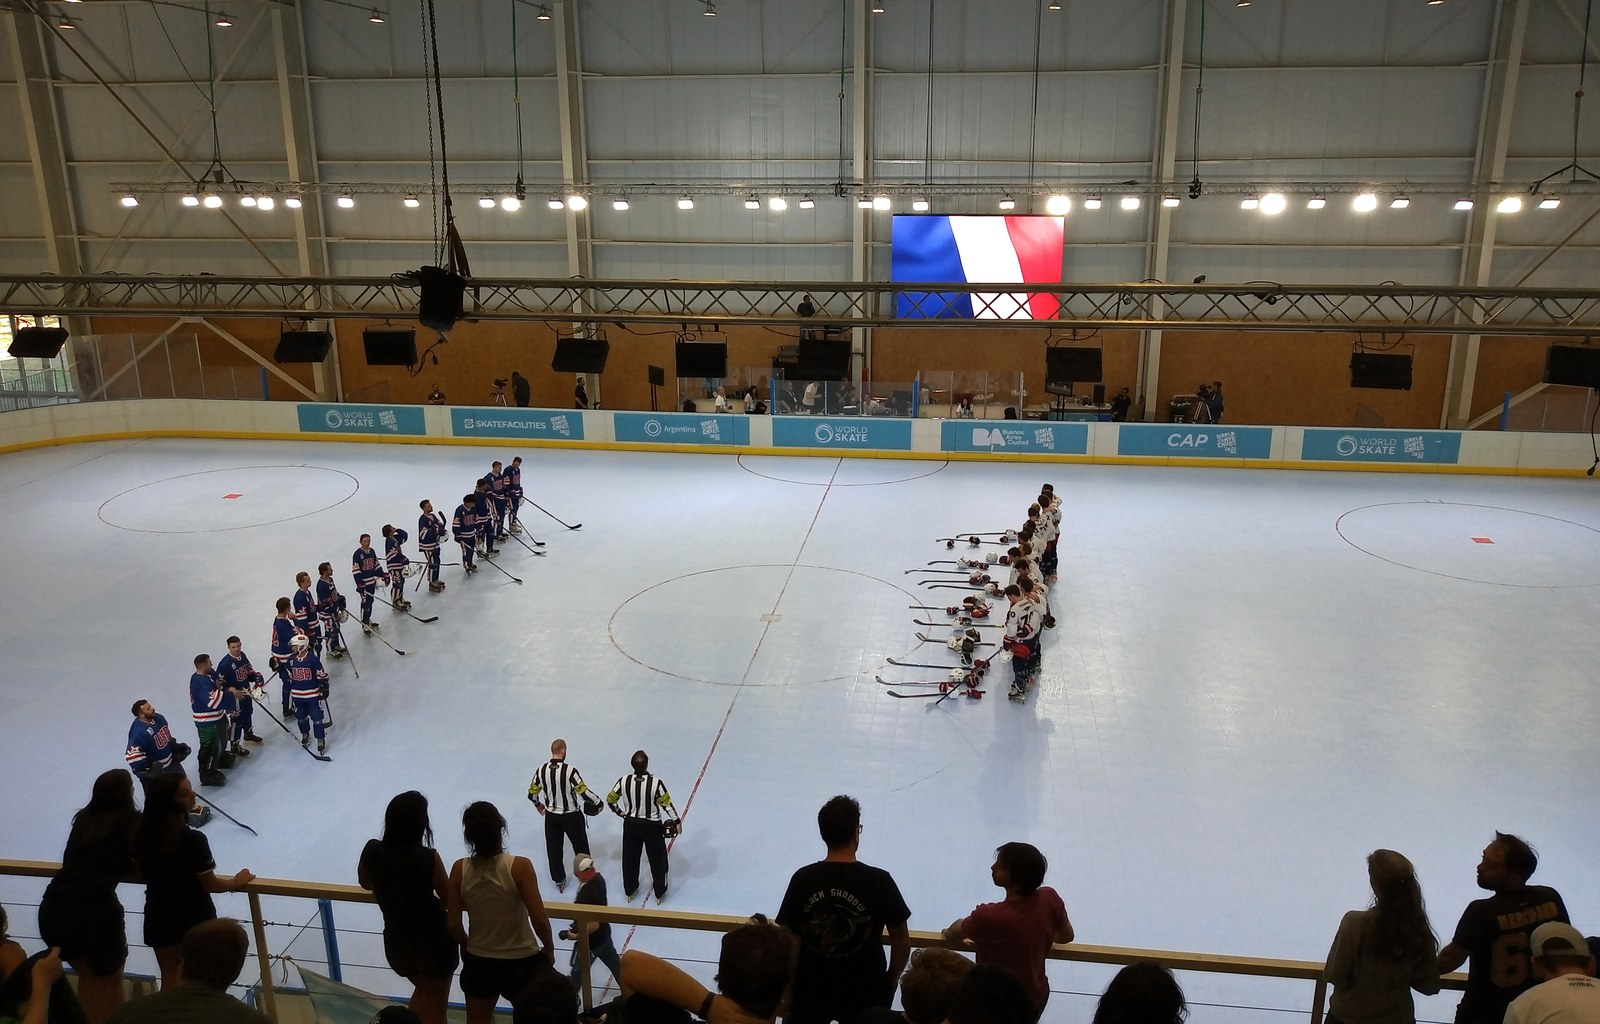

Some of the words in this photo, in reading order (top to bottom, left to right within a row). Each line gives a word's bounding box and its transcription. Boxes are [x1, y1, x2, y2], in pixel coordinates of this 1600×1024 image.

[344, 419, 374, 428] SKATE
[475, 420, 547, 430] SKATEFACILITIES
[664, 425, 696, 434] Argentina
[835, 426, 868, 434] WORLD
[835, 434, 868, 442] SKATE
[1167, 433, 1209, 448] CAP
[1360, 438, 1397, 446] WORLD
[1359, 445, 1396, 455] SKATE
[291, 667, 312, 681] USA
[830, 888, 866, 912] SHADOW
